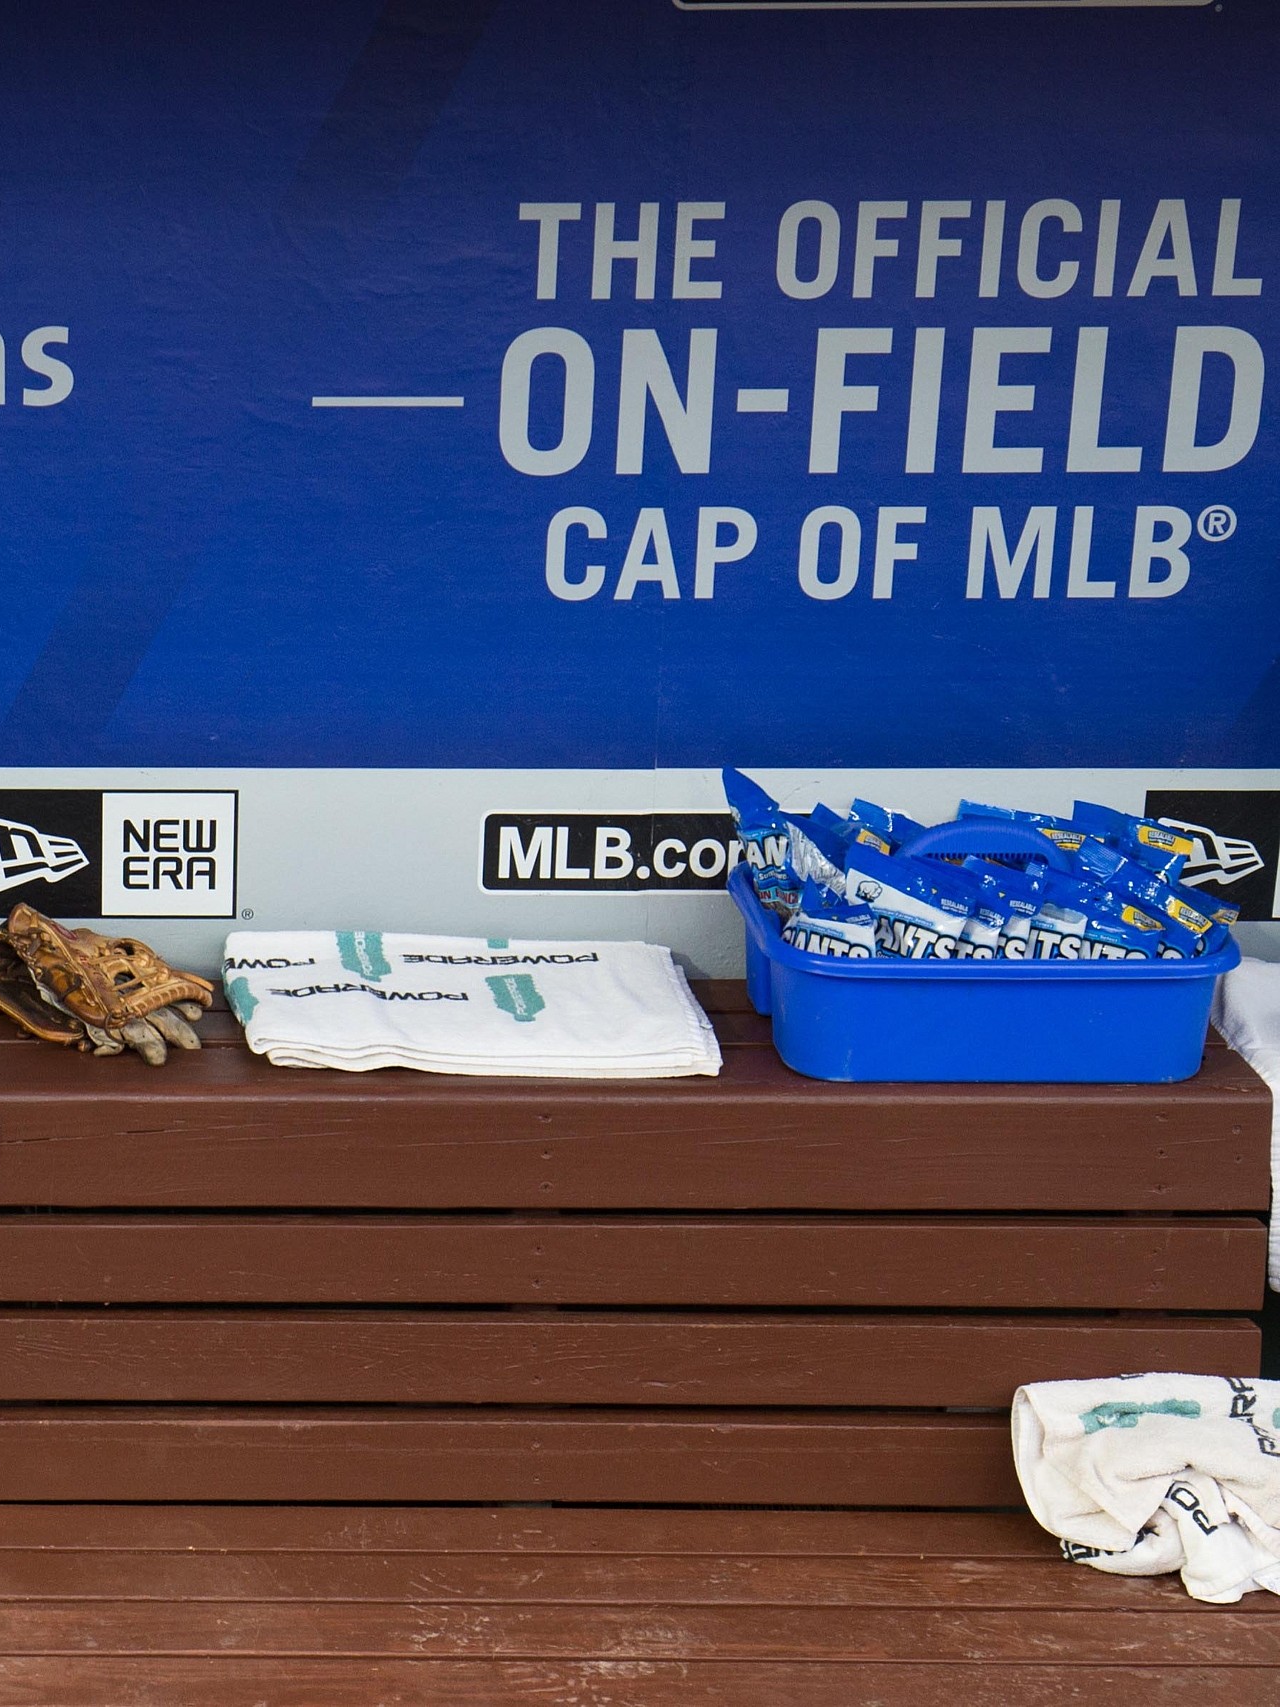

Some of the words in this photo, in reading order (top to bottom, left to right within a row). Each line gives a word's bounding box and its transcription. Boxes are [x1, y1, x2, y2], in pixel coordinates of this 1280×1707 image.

[518, 201, 727, 301] THE
[775, 197, 1264, 301] OFFICIAL
[498, 325, 1266, 477] ON-FIELD
[545, 505, 759, 602] CAP
[797, 505, 928, 602] OF
[122, 818, 218, 854] NEW
[497, 825, 746, 881] MLB.co
[122, 856, 217, 891] ERA
[401, 952, 599, 966] POWERADE
[267, 983, 469, 1001] POWERADE
